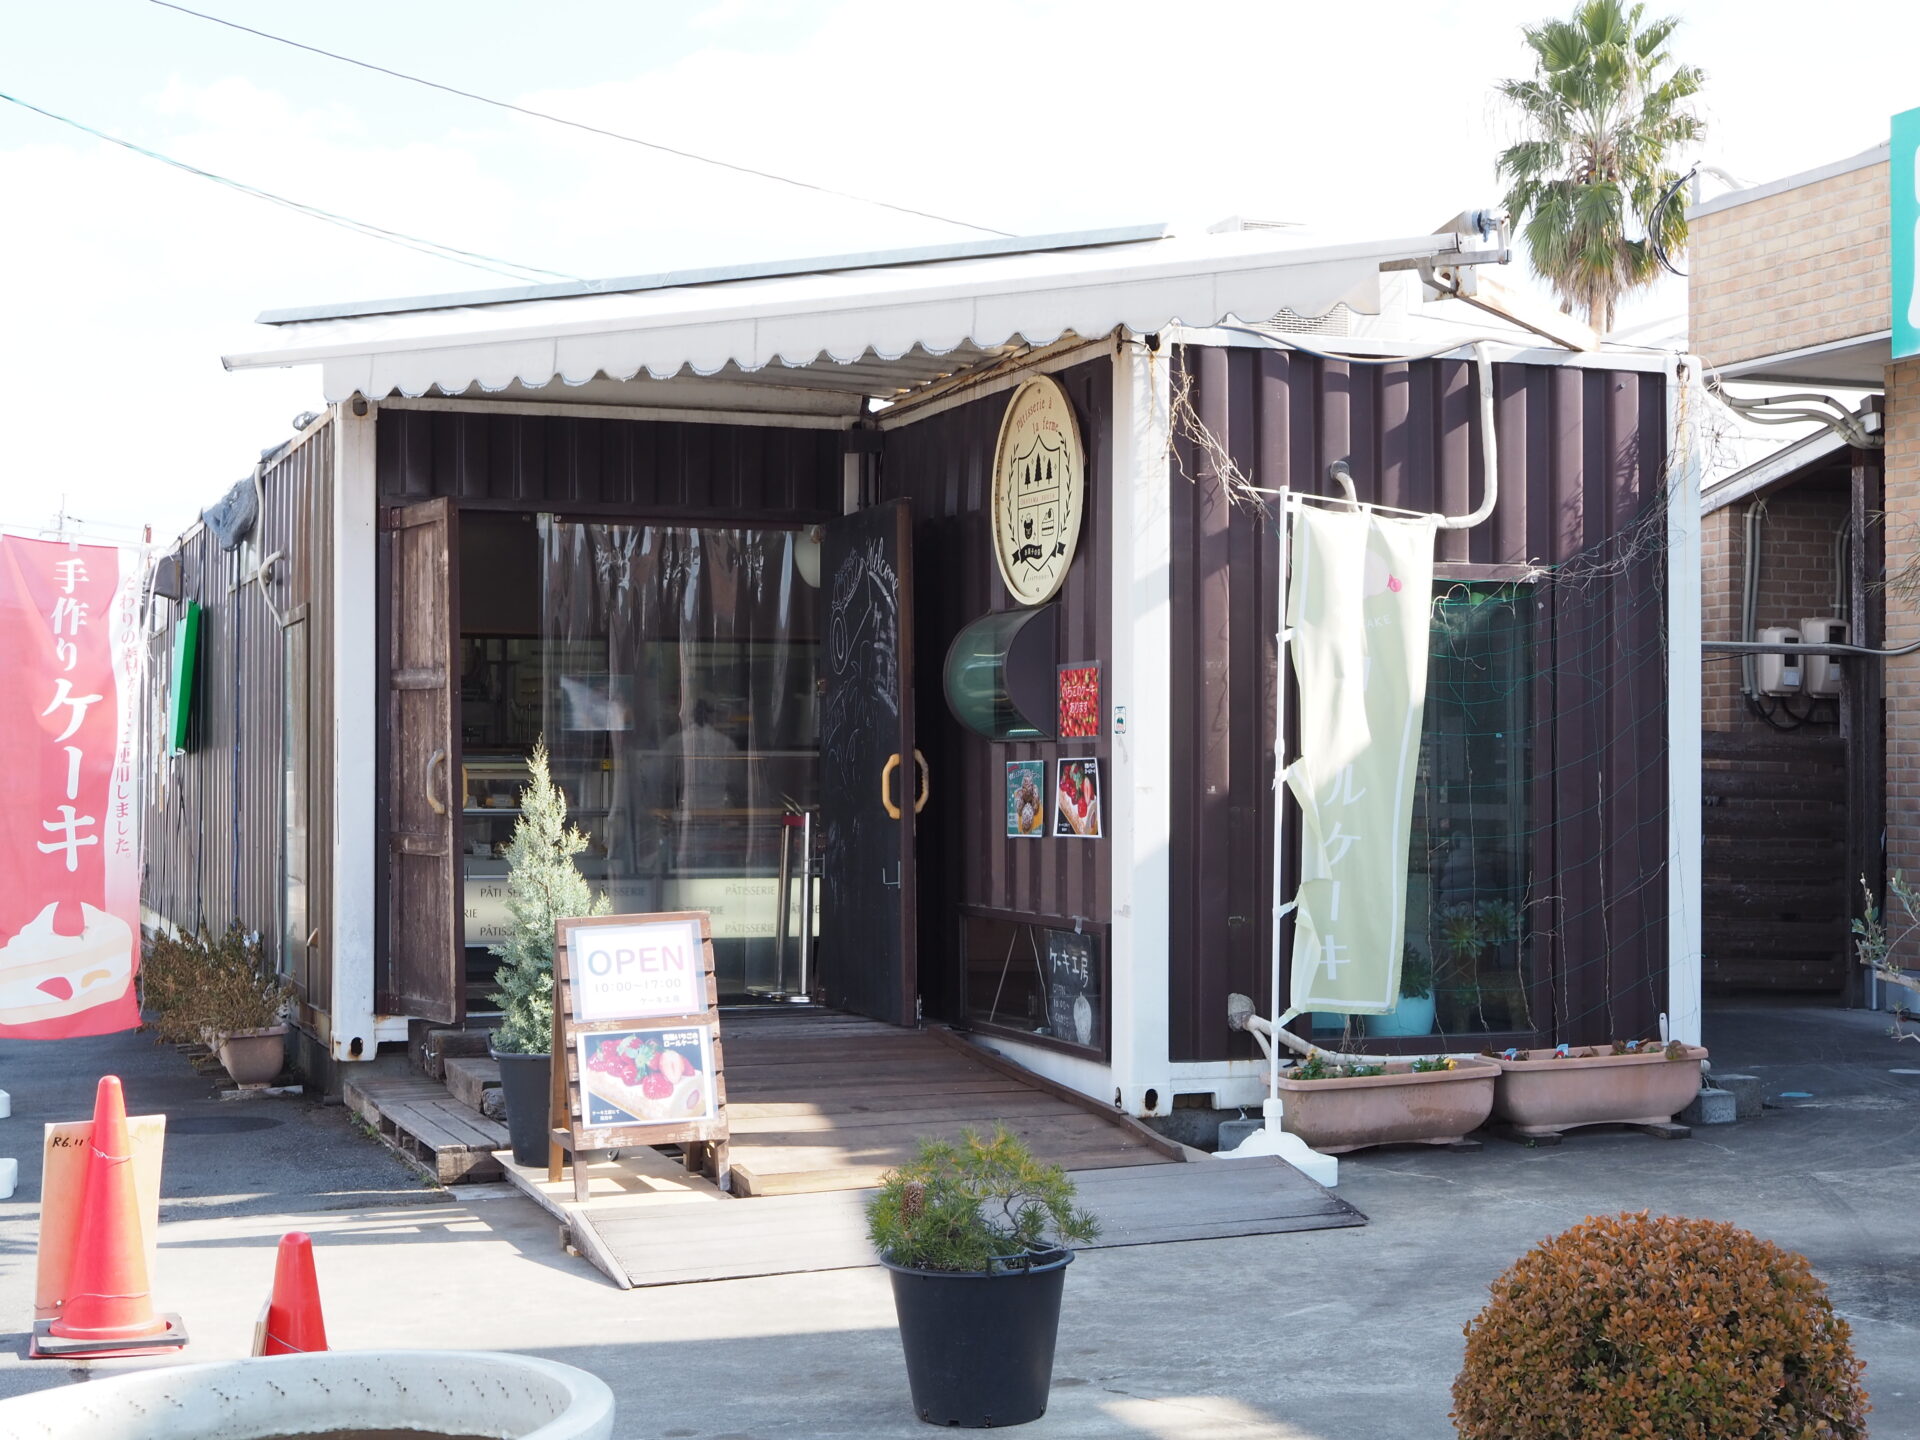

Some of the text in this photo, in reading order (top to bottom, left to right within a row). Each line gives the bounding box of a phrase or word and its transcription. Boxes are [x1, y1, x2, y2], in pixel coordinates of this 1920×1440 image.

[866, 536, 899, 608] Welcome
[1364, 614, 1392, 629] AKE
[38, 558, 103, 872] 手作りケーキ
[587, 944, 684, 976] OPEN
